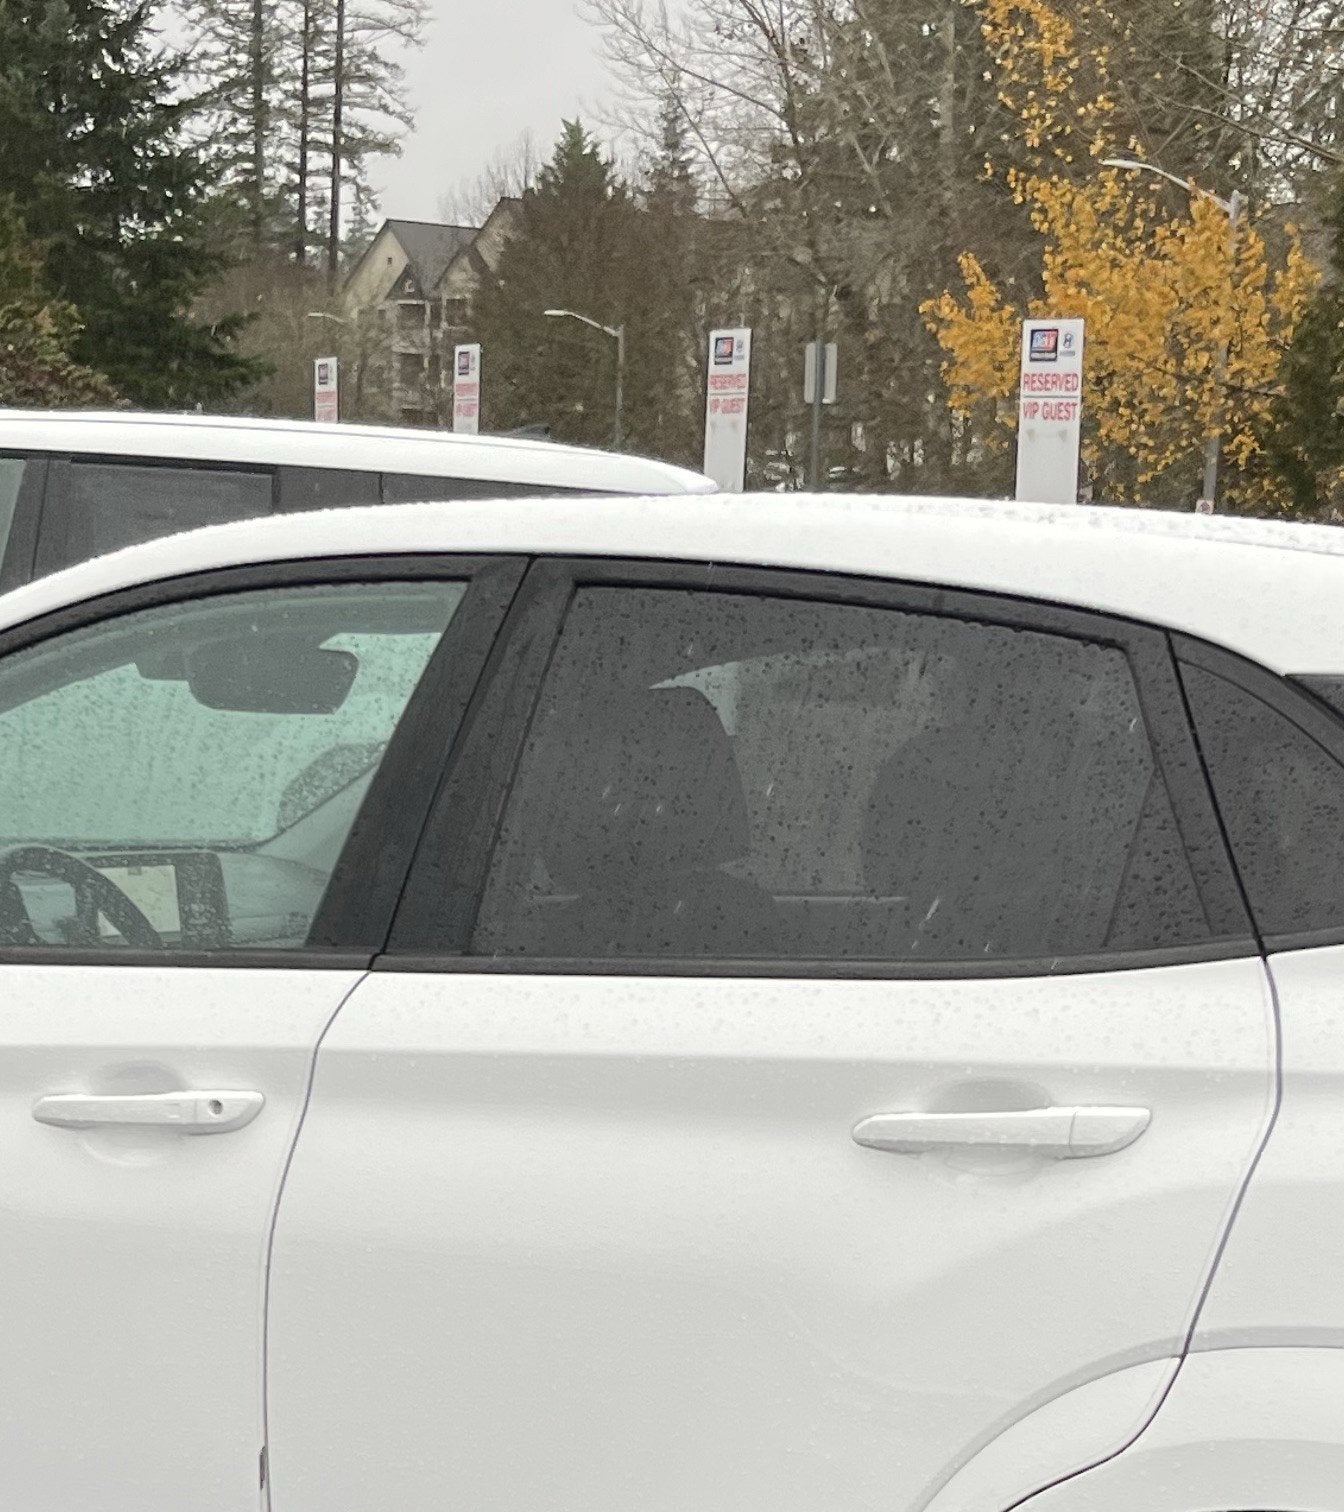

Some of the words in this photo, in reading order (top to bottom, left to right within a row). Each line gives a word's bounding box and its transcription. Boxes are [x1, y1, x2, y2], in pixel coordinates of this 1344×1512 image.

[1023, 372, 1079, 392] RESERVED
[1023, 402, 1039, 420] VIP
[1042, 402, 1077, 421] GUEST
